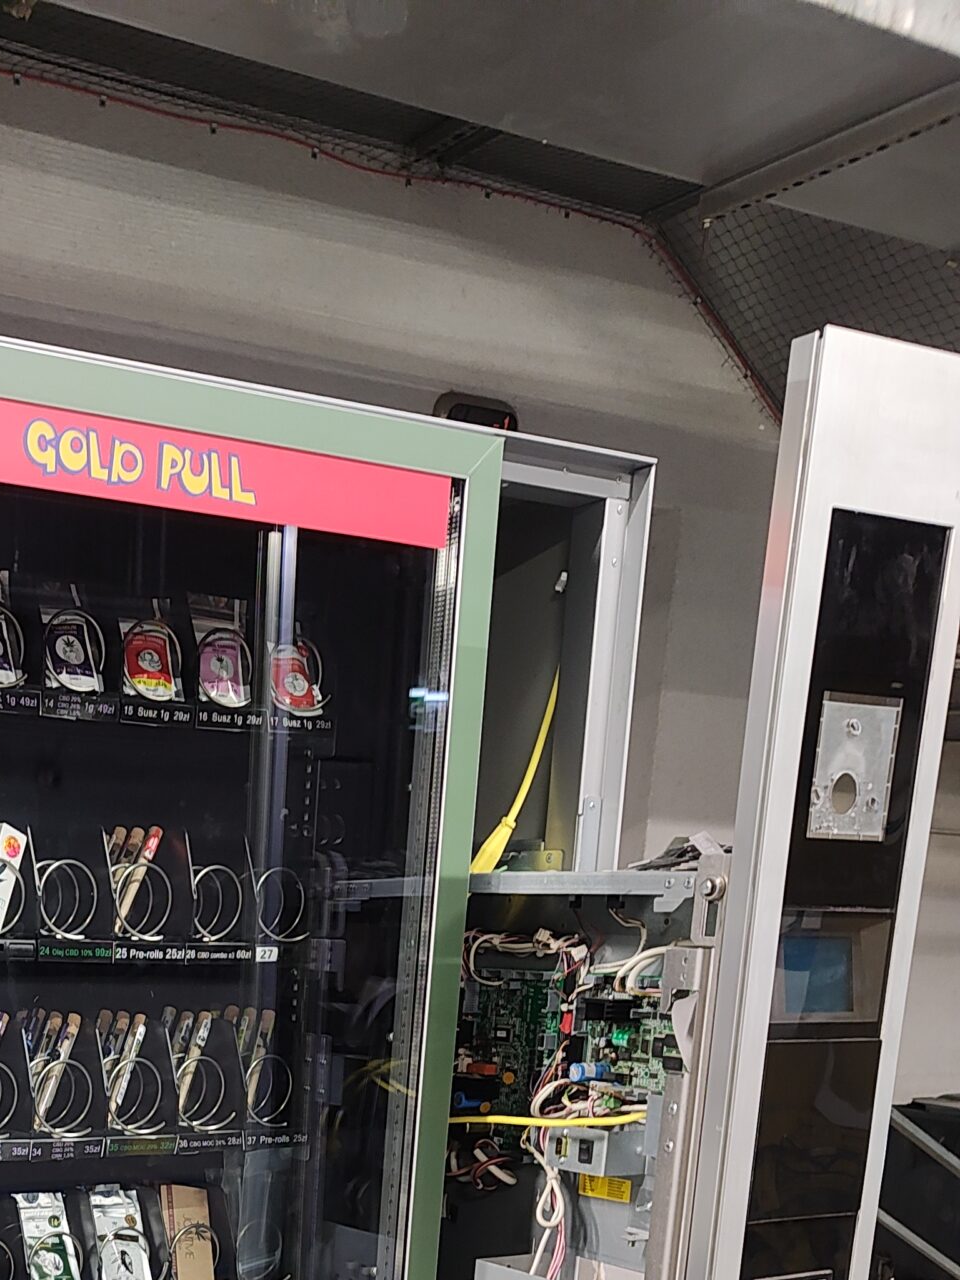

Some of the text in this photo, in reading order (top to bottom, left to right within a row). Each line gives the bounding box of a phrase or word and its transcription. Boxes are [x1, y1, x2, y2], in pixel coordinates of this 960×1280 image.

[23, 418, 257, 506] GOLD PULL
[19, 696, 37, 707] 49zł
[160, 710, 170, 721] 1g
[234, 714, 243, 726] 1g
[304, 719, 312, 730] 1g
[40, 946, 50, 956] 24
[115, 948, 185, 959] 25 Pre-rolls 25zł
[260, 948, 273, 960] 27
[247, 1136, 256, 1145] 37
[12, 1146, 29, 1156] 35zł
[32, 1147, 42, 1157] 34
[84, 1145, 101, 1154] 35zł
